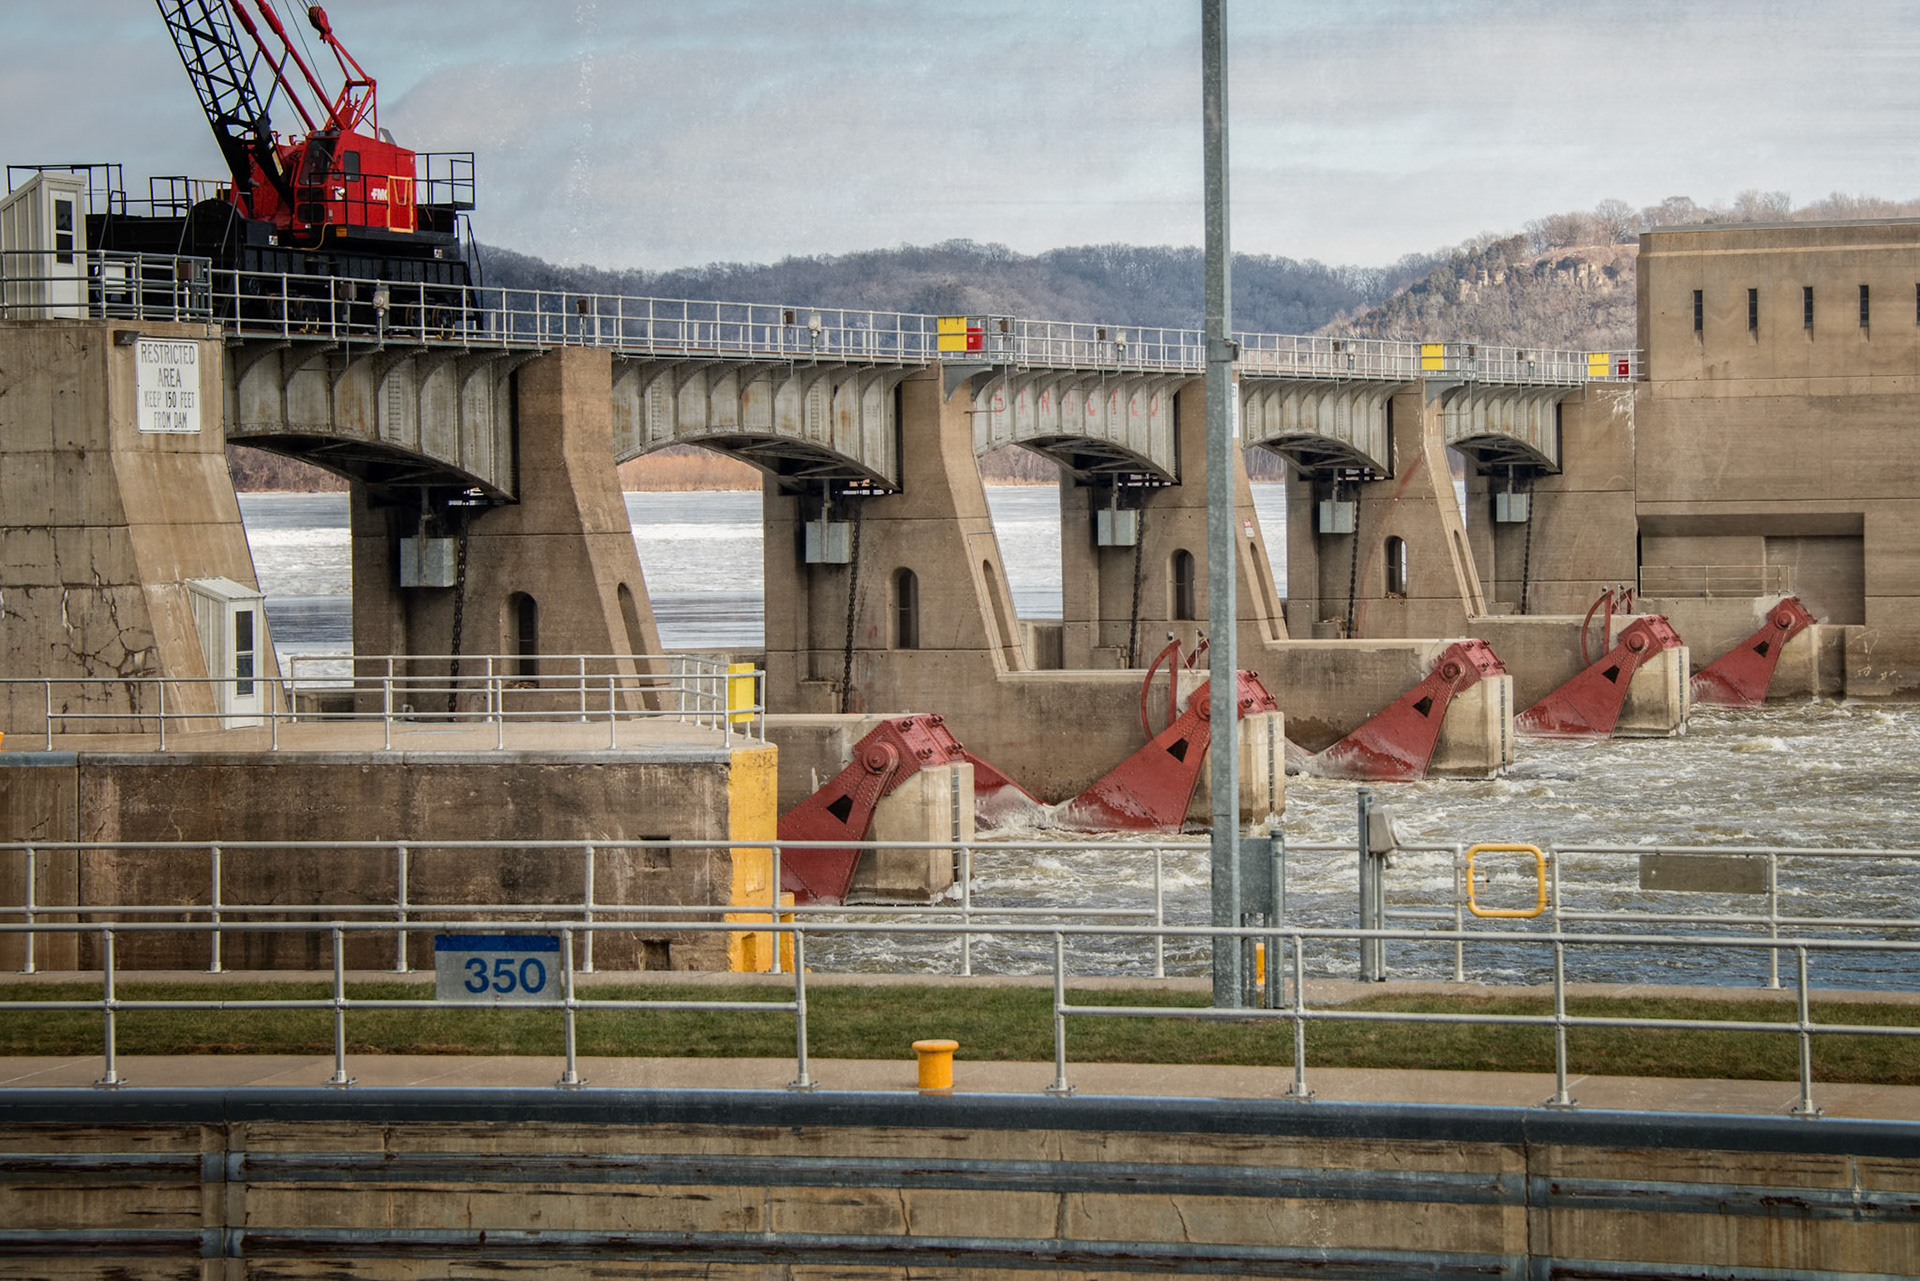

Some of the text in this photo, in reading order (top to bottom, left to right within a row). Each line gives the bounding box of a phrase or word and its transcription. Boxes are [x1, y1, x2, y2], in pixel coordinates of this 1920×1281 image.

[141, 343, 195, 365] RESTRICTED
[158, 368, 182, 387] AREA
[144, 391, 195, 408] KEEP 150 FEET
[154, 411, 188, 428] FROM DAM
[464, 957, 546, 994] 350
